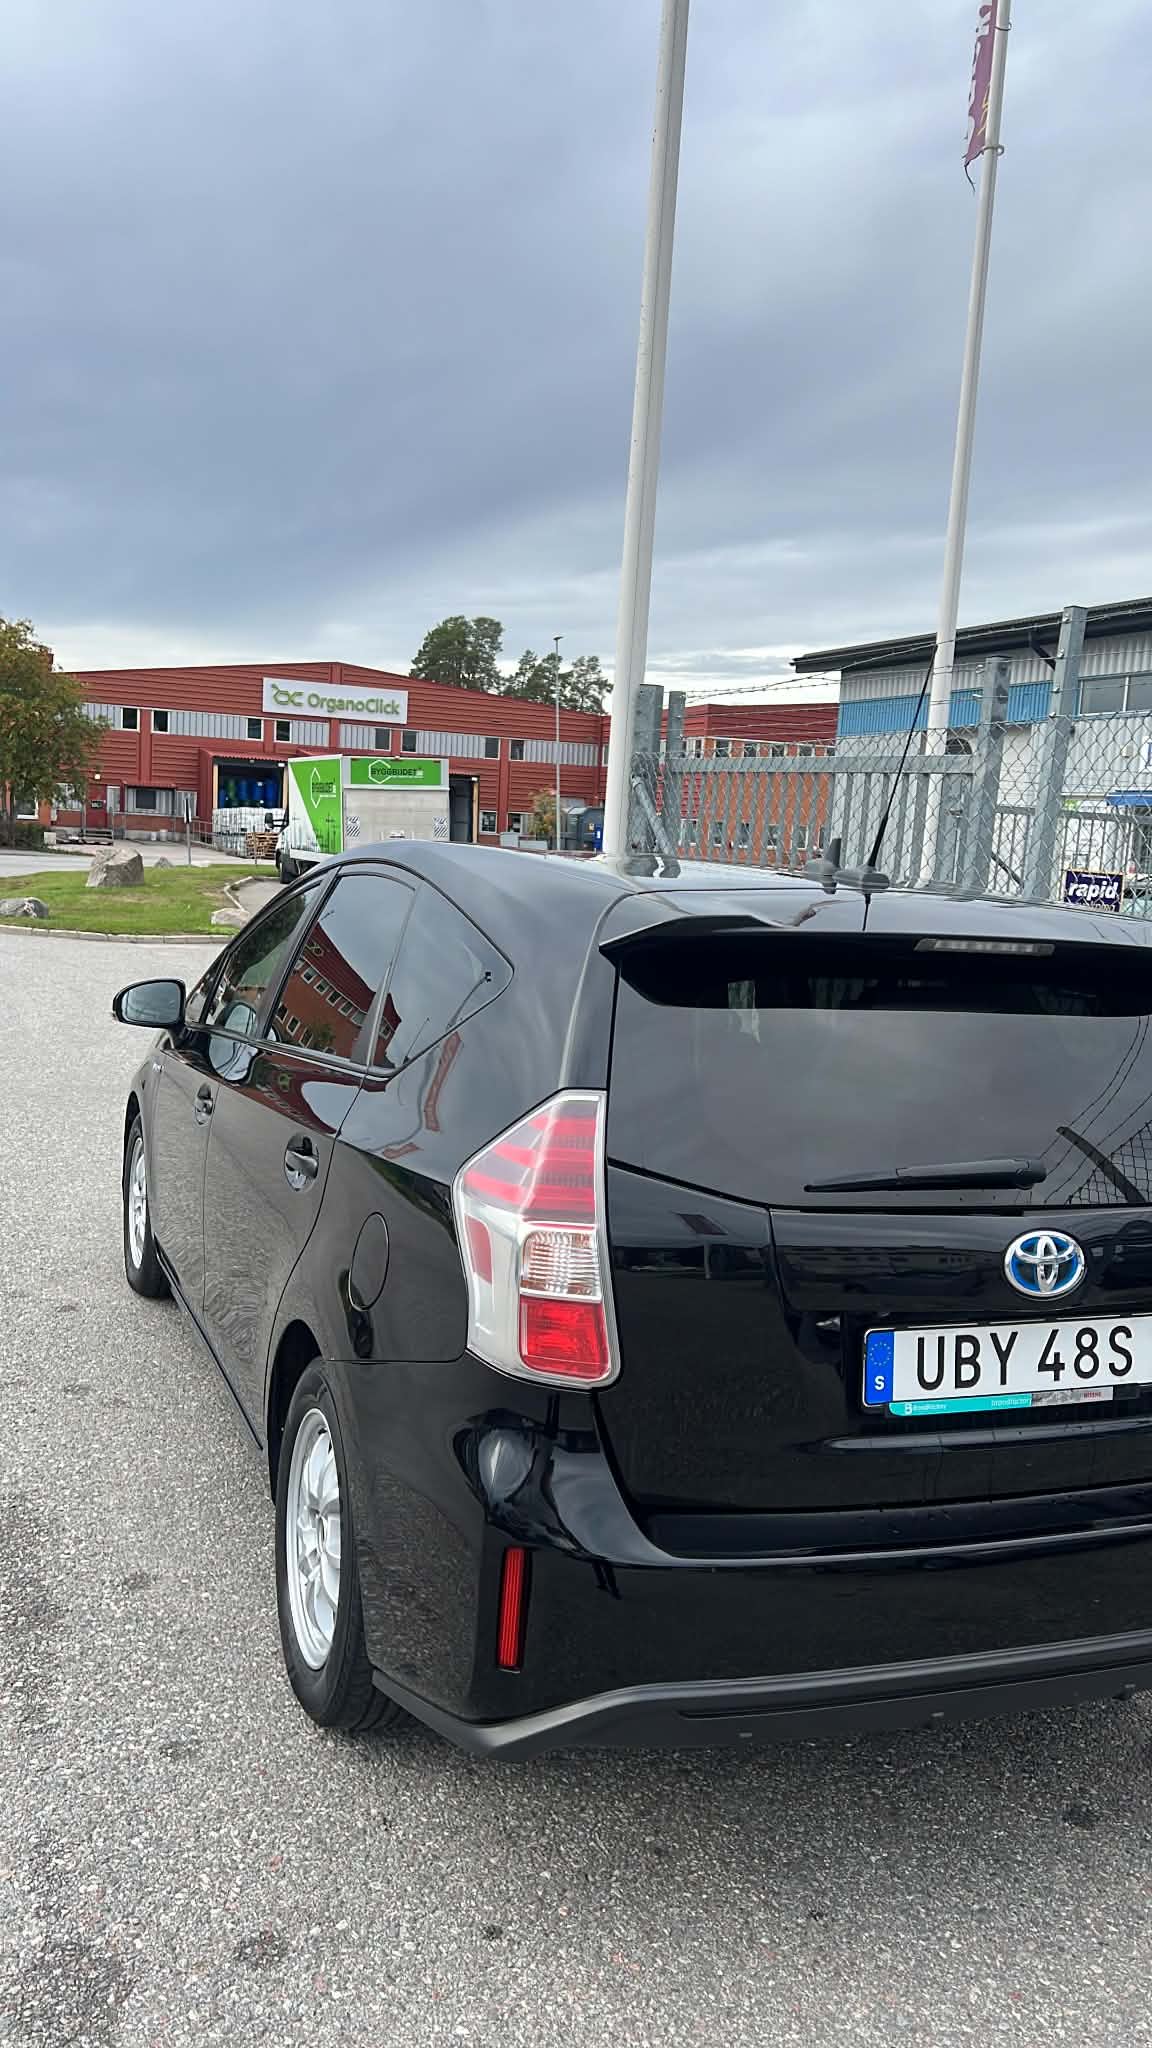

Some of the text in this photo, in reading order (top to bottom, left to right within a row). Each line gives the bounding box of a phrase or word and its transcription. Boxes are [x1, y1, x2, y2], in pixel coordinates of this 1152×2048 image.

[308, 693, 400, 715] OrganoClick
[1068, 880, 1119, 901] rapid
[874, 1325, 1133, 1391] S UBY 48S
